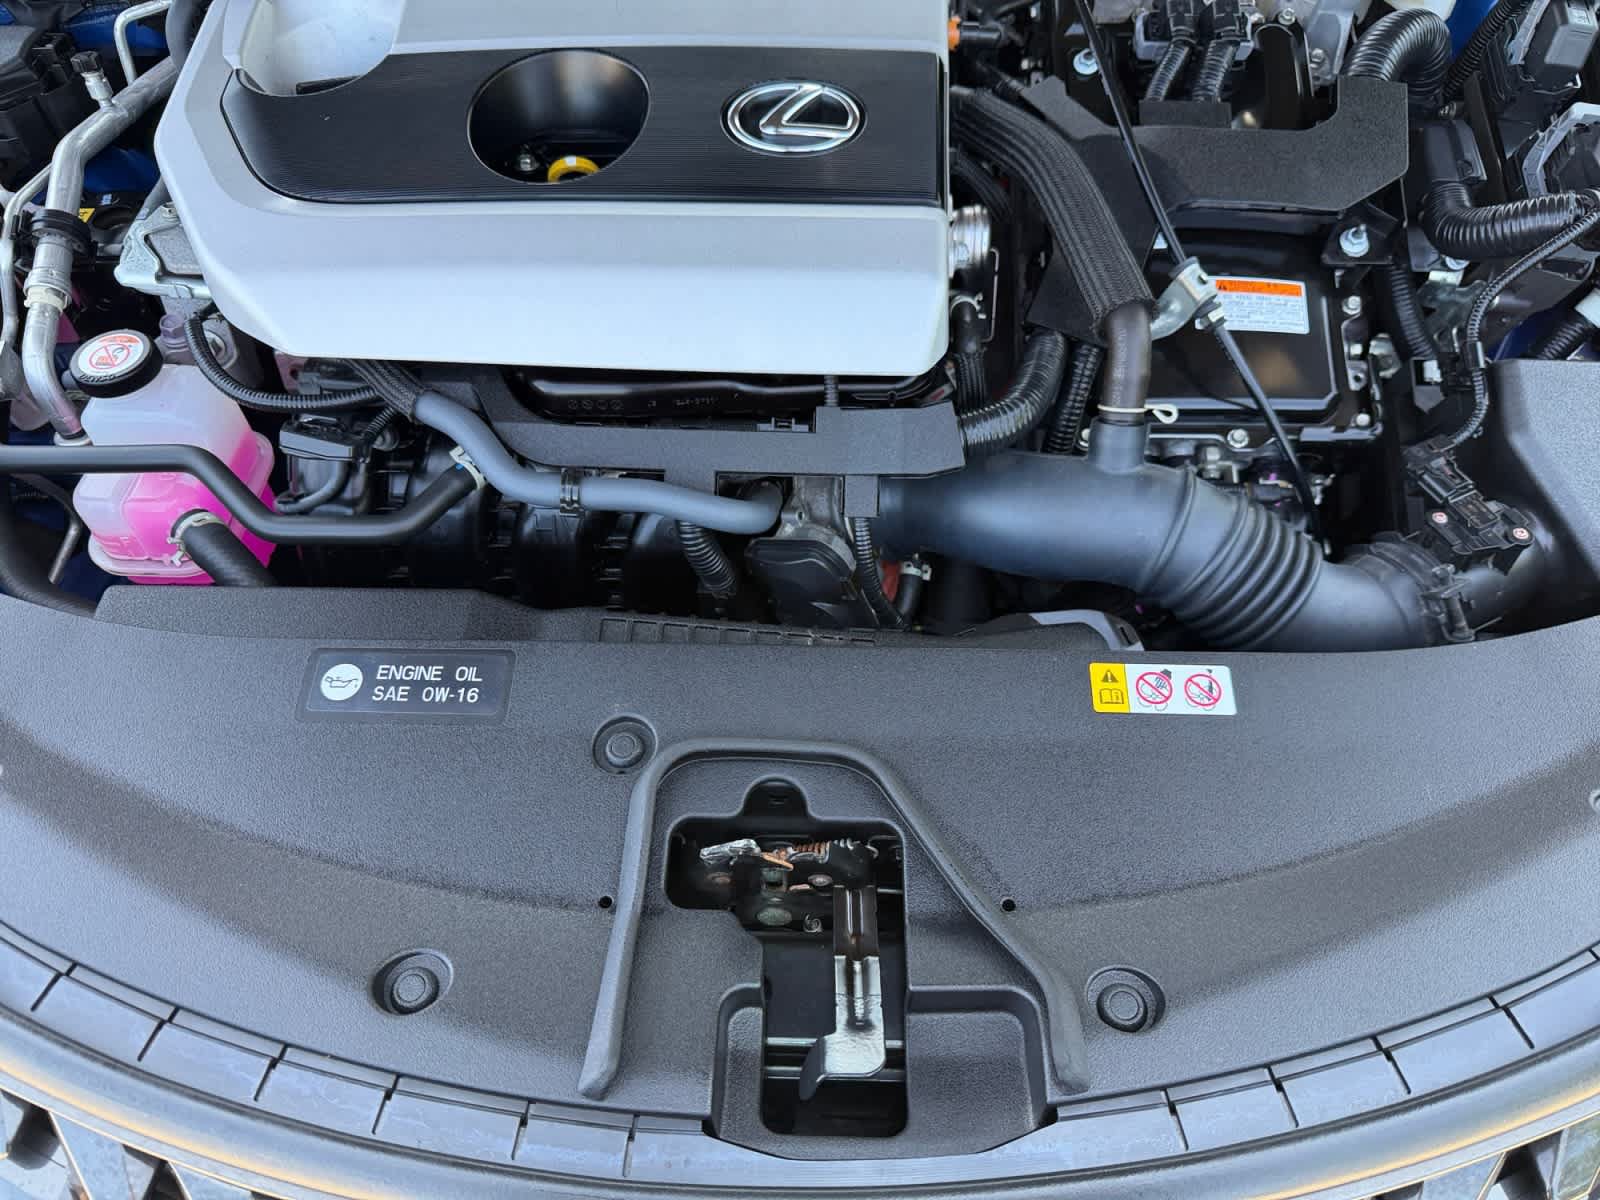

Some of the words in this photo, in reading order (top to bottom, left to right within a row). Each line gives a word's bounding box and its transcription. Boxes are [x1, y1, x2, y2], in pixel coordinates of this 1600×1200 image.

[375, 665, 444, 681] ENGINE
[455, 666, 483, 682] OIL
[372, 686, 411, 702] SAE
[421, 687, 480, 703] 0W-16
